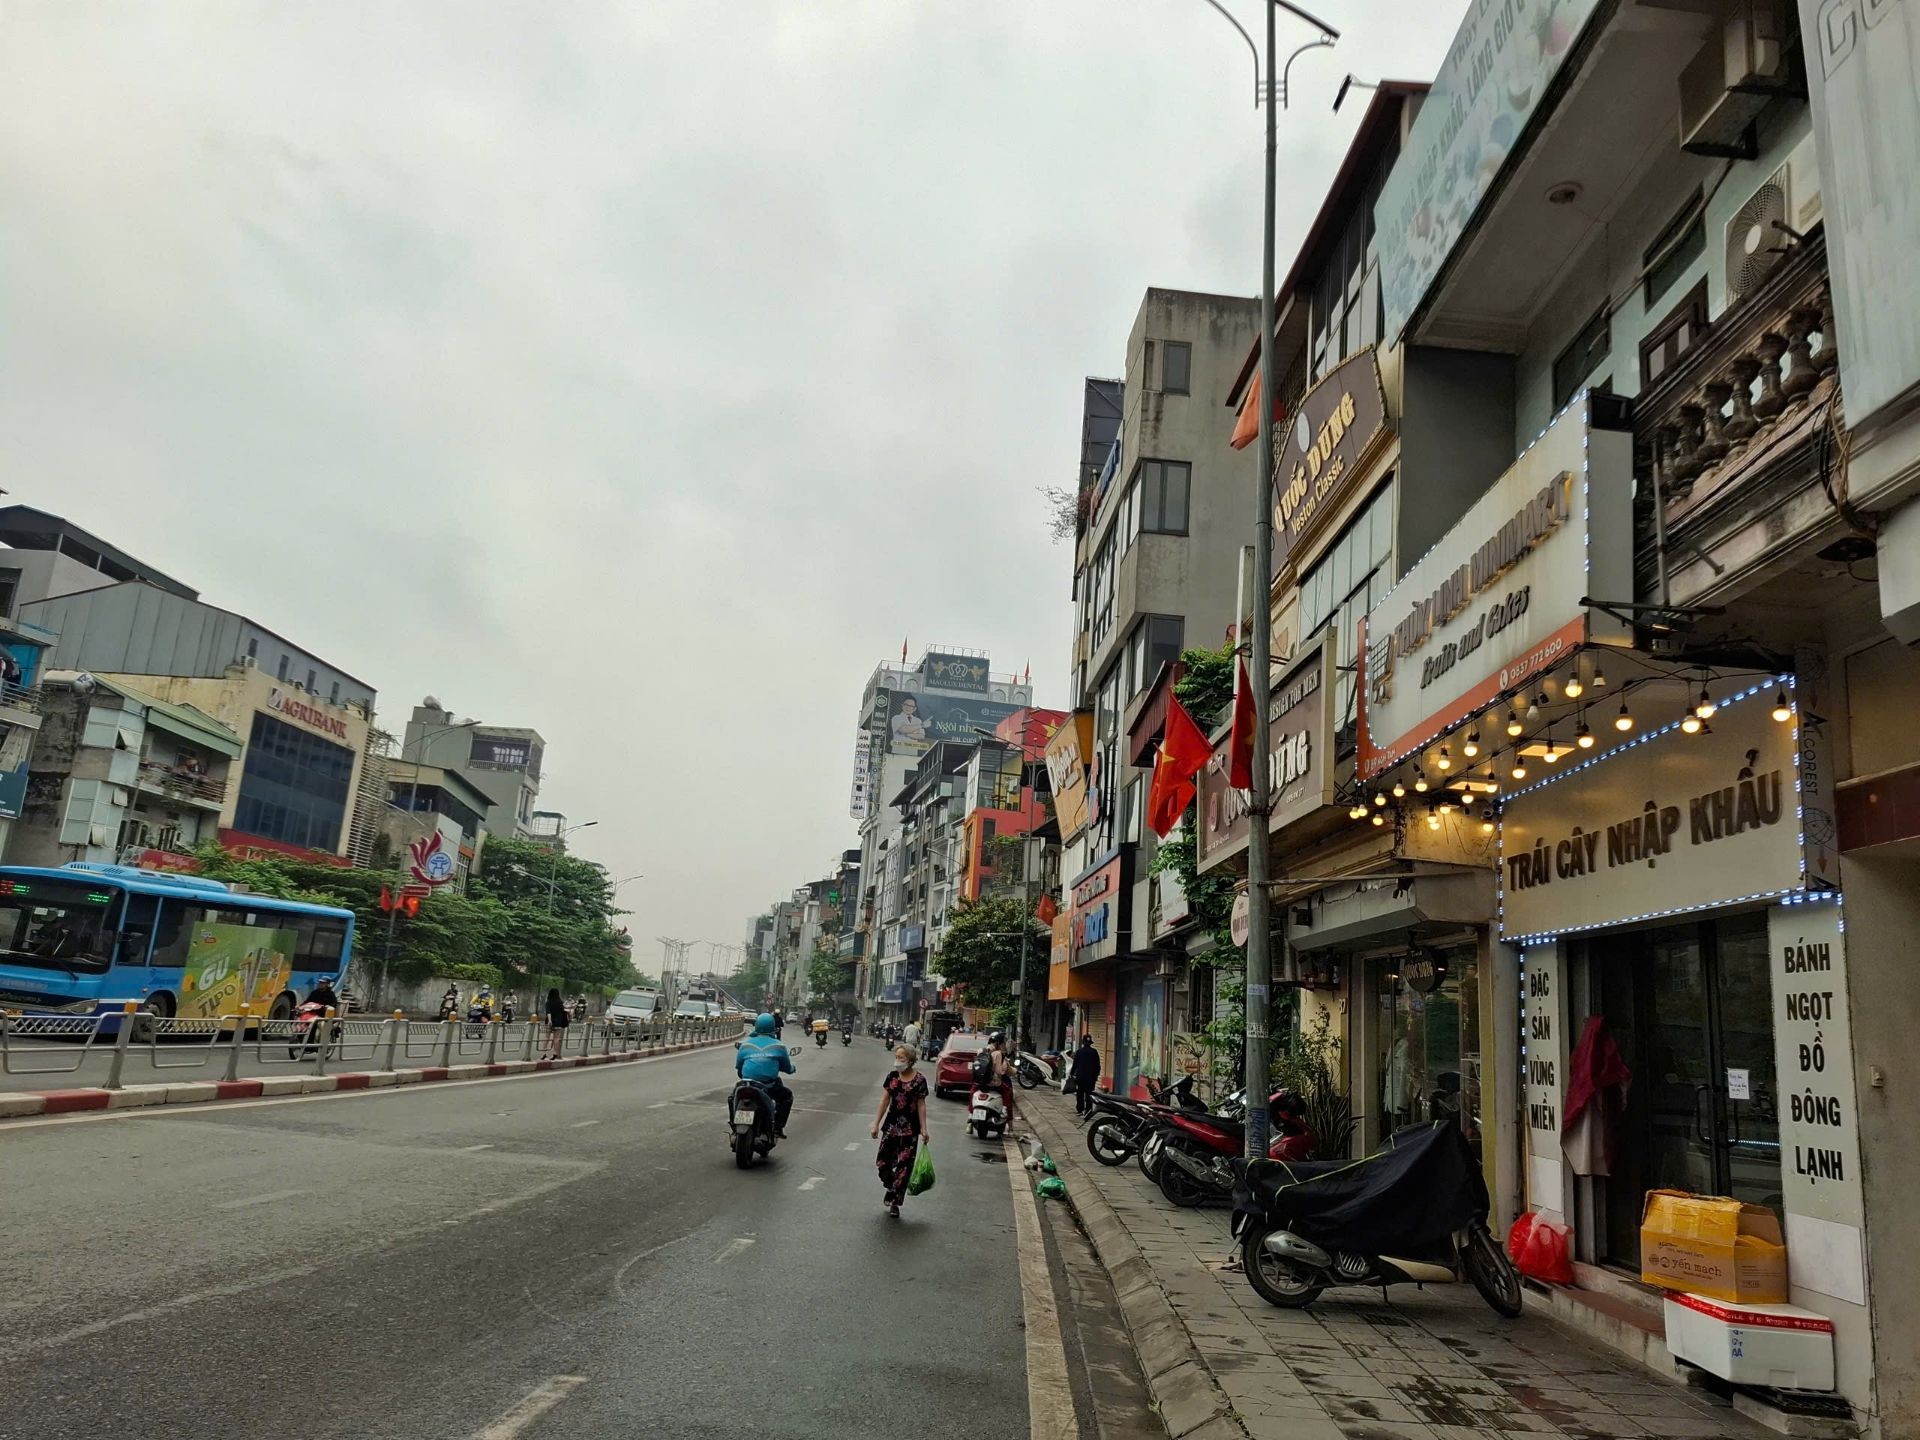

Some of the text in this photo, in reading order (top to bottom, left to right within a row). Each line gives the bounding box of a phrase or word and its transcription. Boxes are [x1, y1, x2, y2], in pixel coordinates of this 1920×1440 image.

[1274, 391, 1356, 532] QUỐC DŨNG
[1291, 454, 1344, 536] Veston Classic
[1470, 471, 1571, 593] MINIMART
[1420, 585, 1531, 689] Fruits and Cakes
[1528, 652, 1544, 669] 772
[1544, 638, 1562, 659] 600
[958, 683, 985, 691] DENTAL
[283, 698, 347, 739] AGRIBANK
[936, 721, 957, 734] Ngôi
[1507, 749, 1783, 891] TRÁI CÂY NHẬP KHẨU
[1784, 937, 1831, 973] BÁNH
[199, 984, 236, 1018] TIPO
[1530, 968, 1550, 1001] ĐẶC
[1532, 1006, 1551, 1040] SẢN
[1786, 992, 1833, 1027] NGỌT
[1799, 1030, 1825, 1072] ĐỒ
[1530, 1054, 1555, 1086] VÙNG
[1531, 1091, 1555, 1131] MIỀN
[1791, 1087, 1841, 1127] ĐÔNG
[1795, 1146, 1844, 1185] LẠNH
[1672, 1257, 1691, 1270] yến
